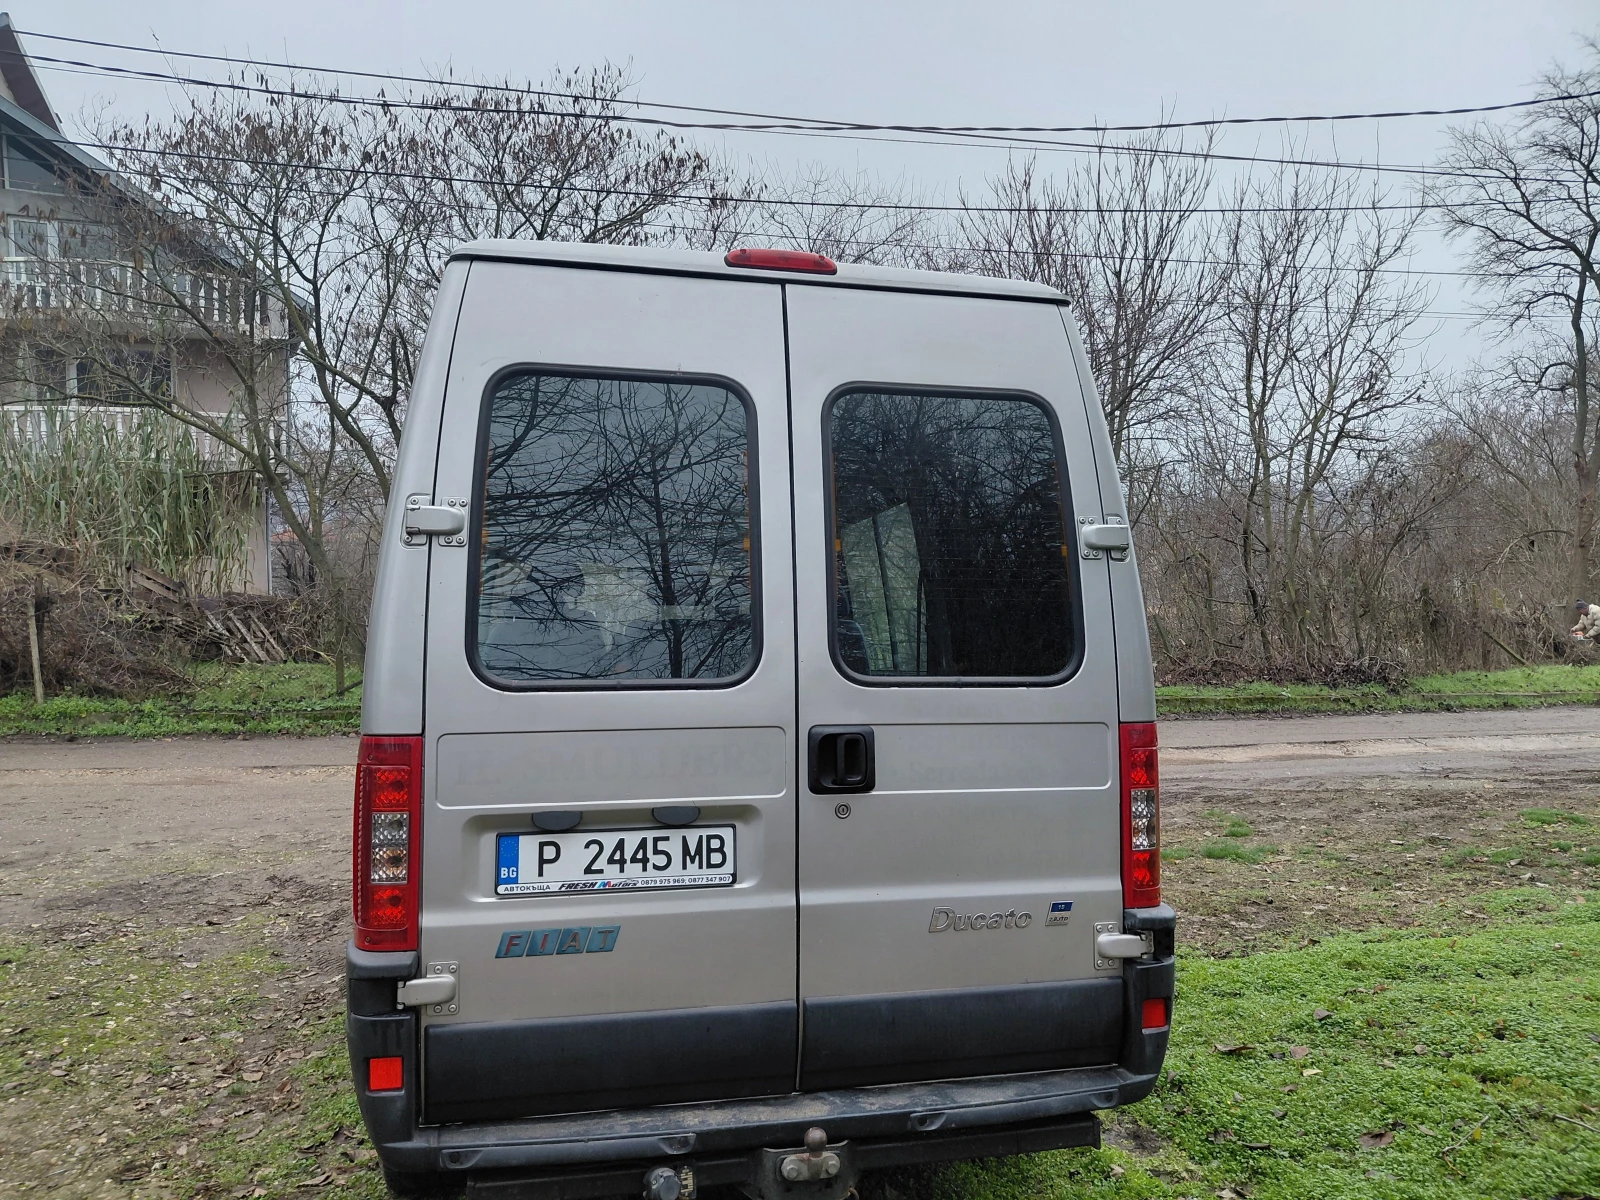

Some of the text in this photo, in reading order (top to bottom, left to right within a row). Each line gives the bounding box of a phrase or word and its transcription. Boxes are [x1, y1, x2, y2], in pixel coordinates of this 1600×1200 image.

[538, 834, 728, 877] P 2445 MB
[501, 867, 517, 879] BG
[503, 884, 551, 893] АВТОКЪЩА
[558, 882, 598, 891] FRESH
[598, 880, 638, 889] Motors
[928, 906, 1032, 933] Ducato
[503, 928, 615, 956] FIAT
